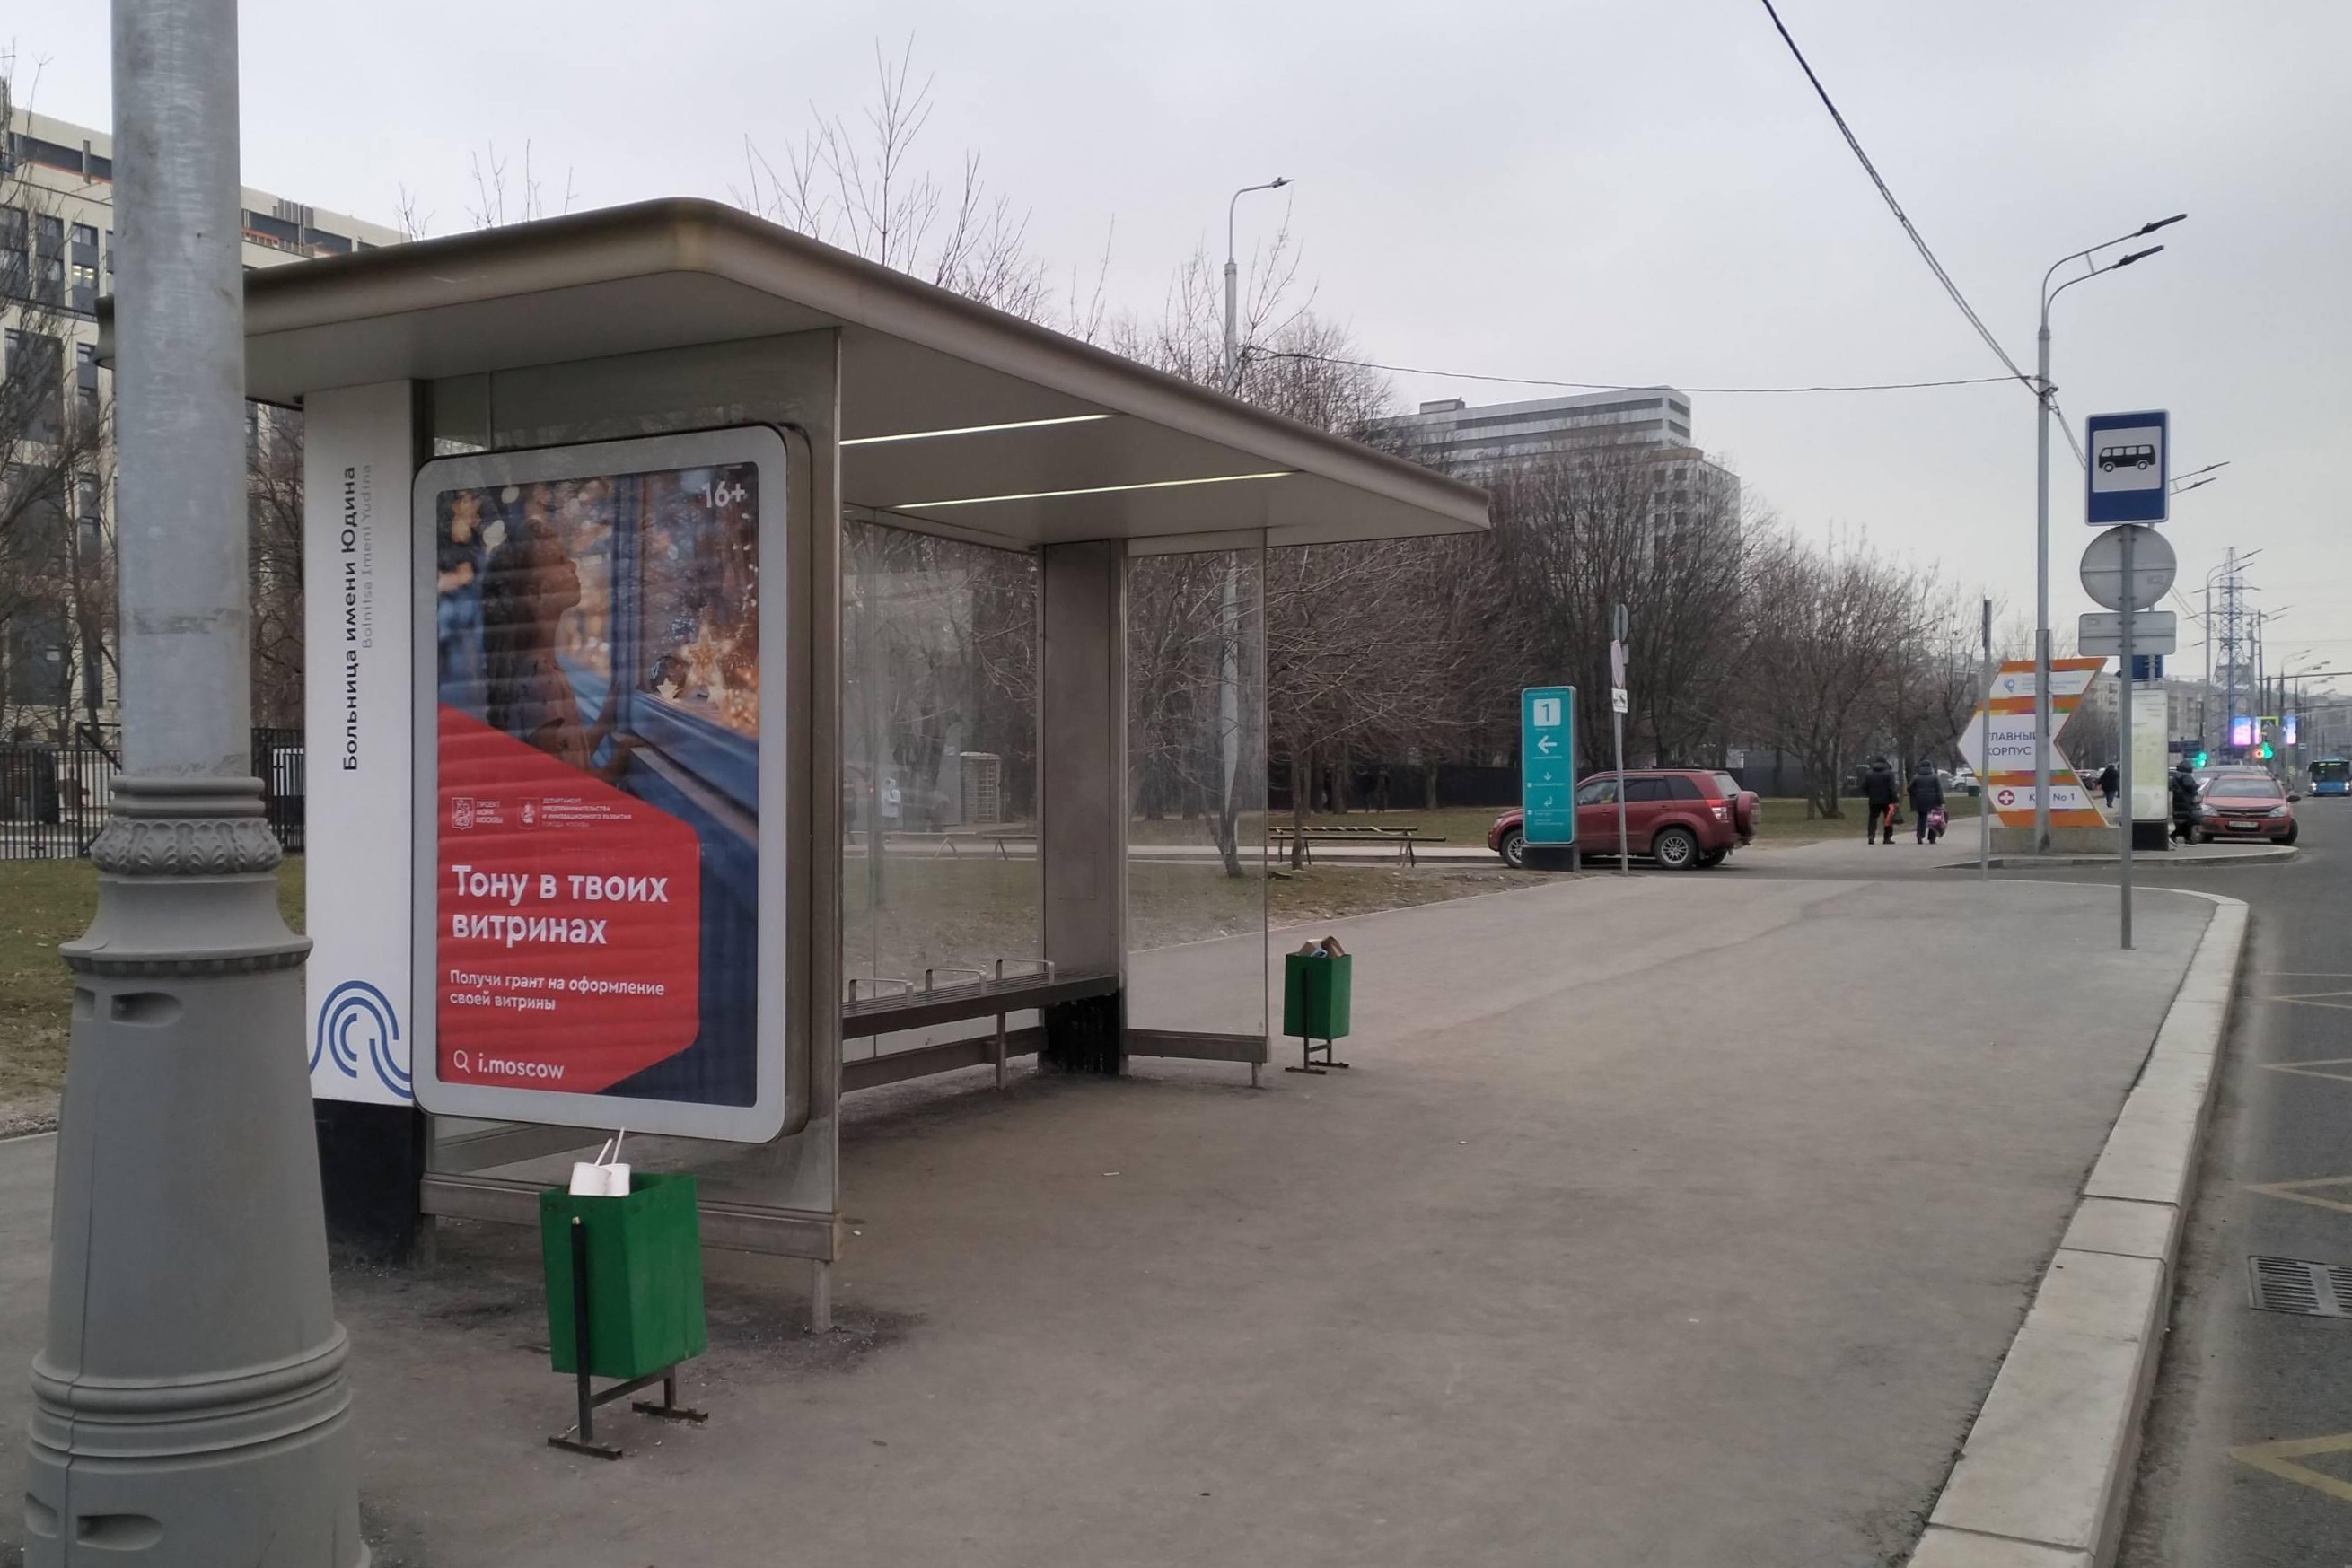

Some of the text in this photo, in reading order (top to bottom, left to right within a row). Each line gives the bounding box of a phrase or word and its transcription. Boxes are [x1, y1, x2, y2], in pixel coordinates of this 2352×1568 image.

[701, 480, 746, 509] 16+
[360, 464, 373, 649] Bolnitsa Imeni Yudina
[341, 466, 359, 770] Больница имени Юдина
[1541, 703, 1550, 723] 1
[1988, 731, 2036, 742] ЛАВНЫ
[452, 864, 669, 906] Тону в твоих
[452, 914, 608, 948] витринах
[450, 969, 665, 996] Получи грант на оформление
[450, 990, 556, 1012] своей витрины
[478, 1053, 565, 1080] i.moscow
